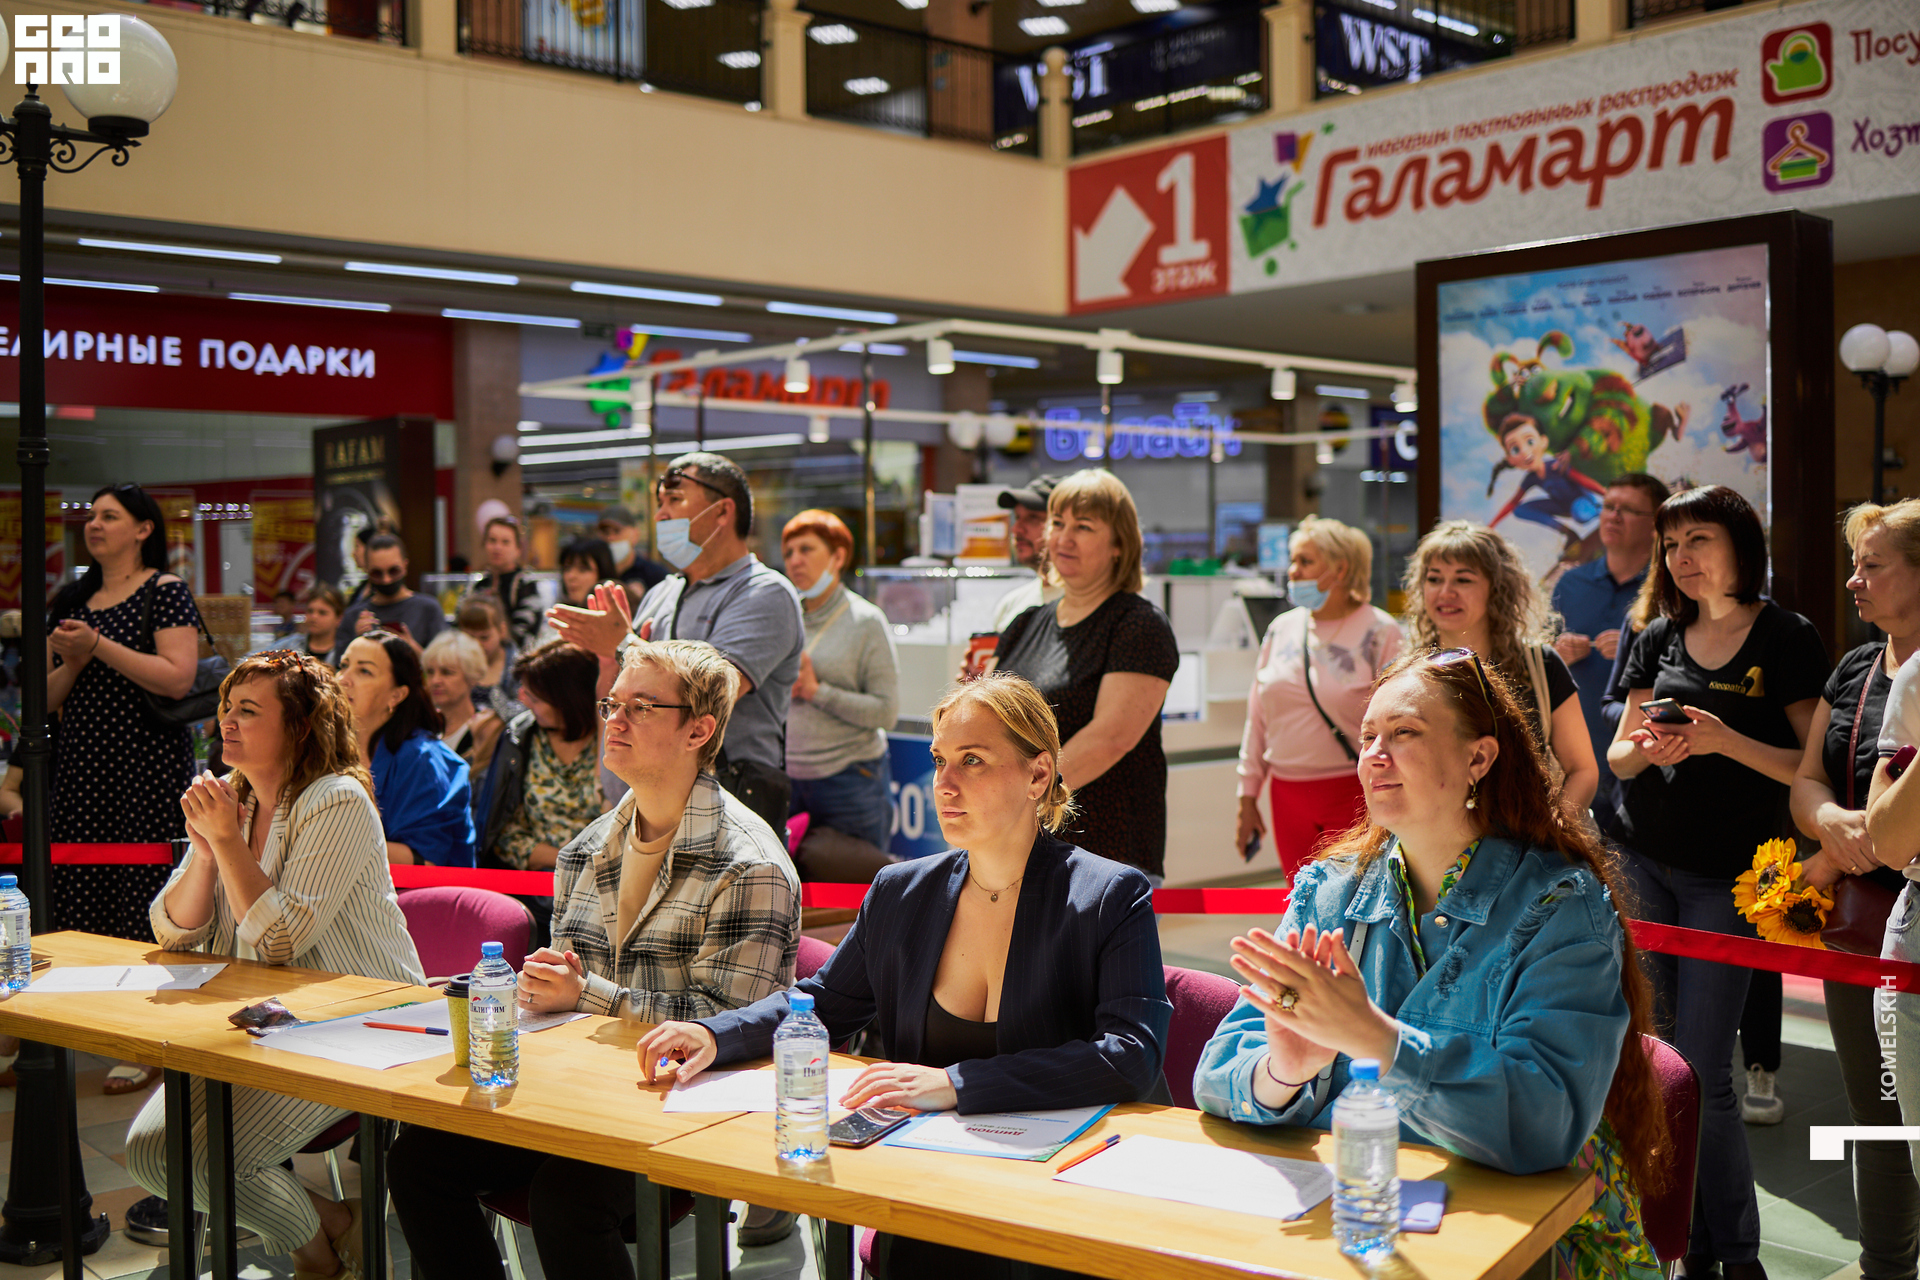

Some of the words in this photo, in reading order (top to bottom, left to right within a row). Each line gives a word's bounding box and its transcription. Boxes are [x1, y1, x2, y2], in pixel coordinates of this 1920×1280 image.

[1453, 96, 1595, 144] постоянных
[1598, 67, 1740, 117] распродаж
[1312, 97, 1736, 229] Галамарт
[1156, 152, 1211, 265] 1
[1152, 260, 1218, 294] этаж
[200, 338, 376, 379] ПОДАРКИ
[1708, 680, 1746, 695] Kleopatra
[966, 1126, 1025, 1137] ДИПЛОМ
